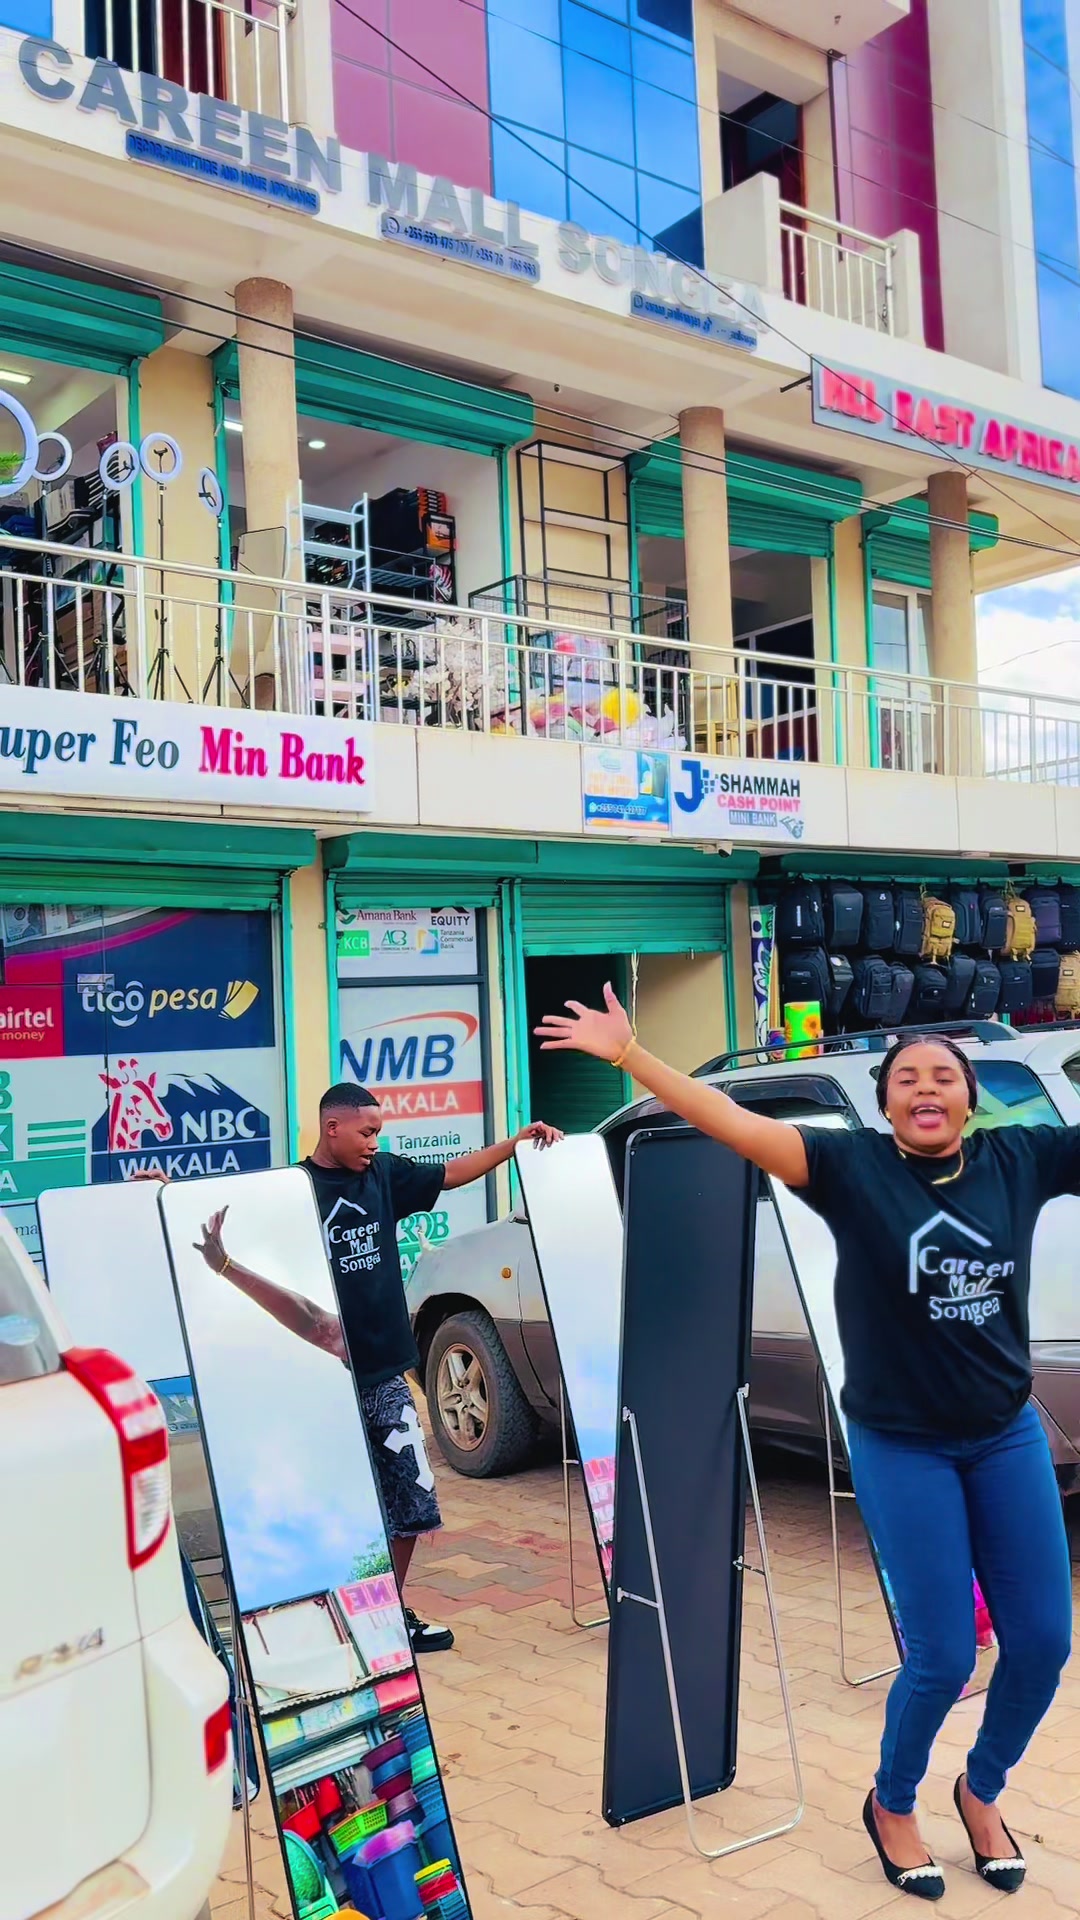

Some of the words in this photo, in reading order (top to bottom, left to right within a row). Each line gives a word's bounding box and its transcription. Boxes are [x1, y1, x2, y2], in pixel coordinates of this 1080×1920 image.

[18, 34, 343, 195] CAREEN
[366, 151, 541, 252] MALL
[558, 220, 772, 334] SONGEA
[241, 170, 267, 192] HOME
[893, 389, 976, 449] EAST
[109, 718, 180, 769] Feo
[199, 725, 268, 777] Min
[278, 732, 366, 785] Bank
[719, 773, 801, 798] SHAMMAH
[717, 793, 756, 810] CASH
[759, 797, 801, 813] POINT
[730, 811, 750, 825] MINI
[751, 813, 777, 827] BANK
[356, 910, 392, 921] Amana
[393, 910, 417, 921] Bank
[431, 916, 470, 926] EQUITY
[344, 937, 368, 950] KCB
[148, 987, 218, 1018] pesa
[2, 1031, 45, 1042] money
[340, 1034, 456, 1083] NMB
[380, 1089, 460, 1116] AKALA
[181, 1107, 257, 1144] NBC
[396, 1131, 461, 1150] Tanzania
[328, 1221, 380, 1244] Careen
[349, 1235, 374, 1255] Mall
[918, 1246, 1015, 1277] Careen
[948, 1275, 994, 1297] Mall
[929, 1297, 1001, 1325] Songea
